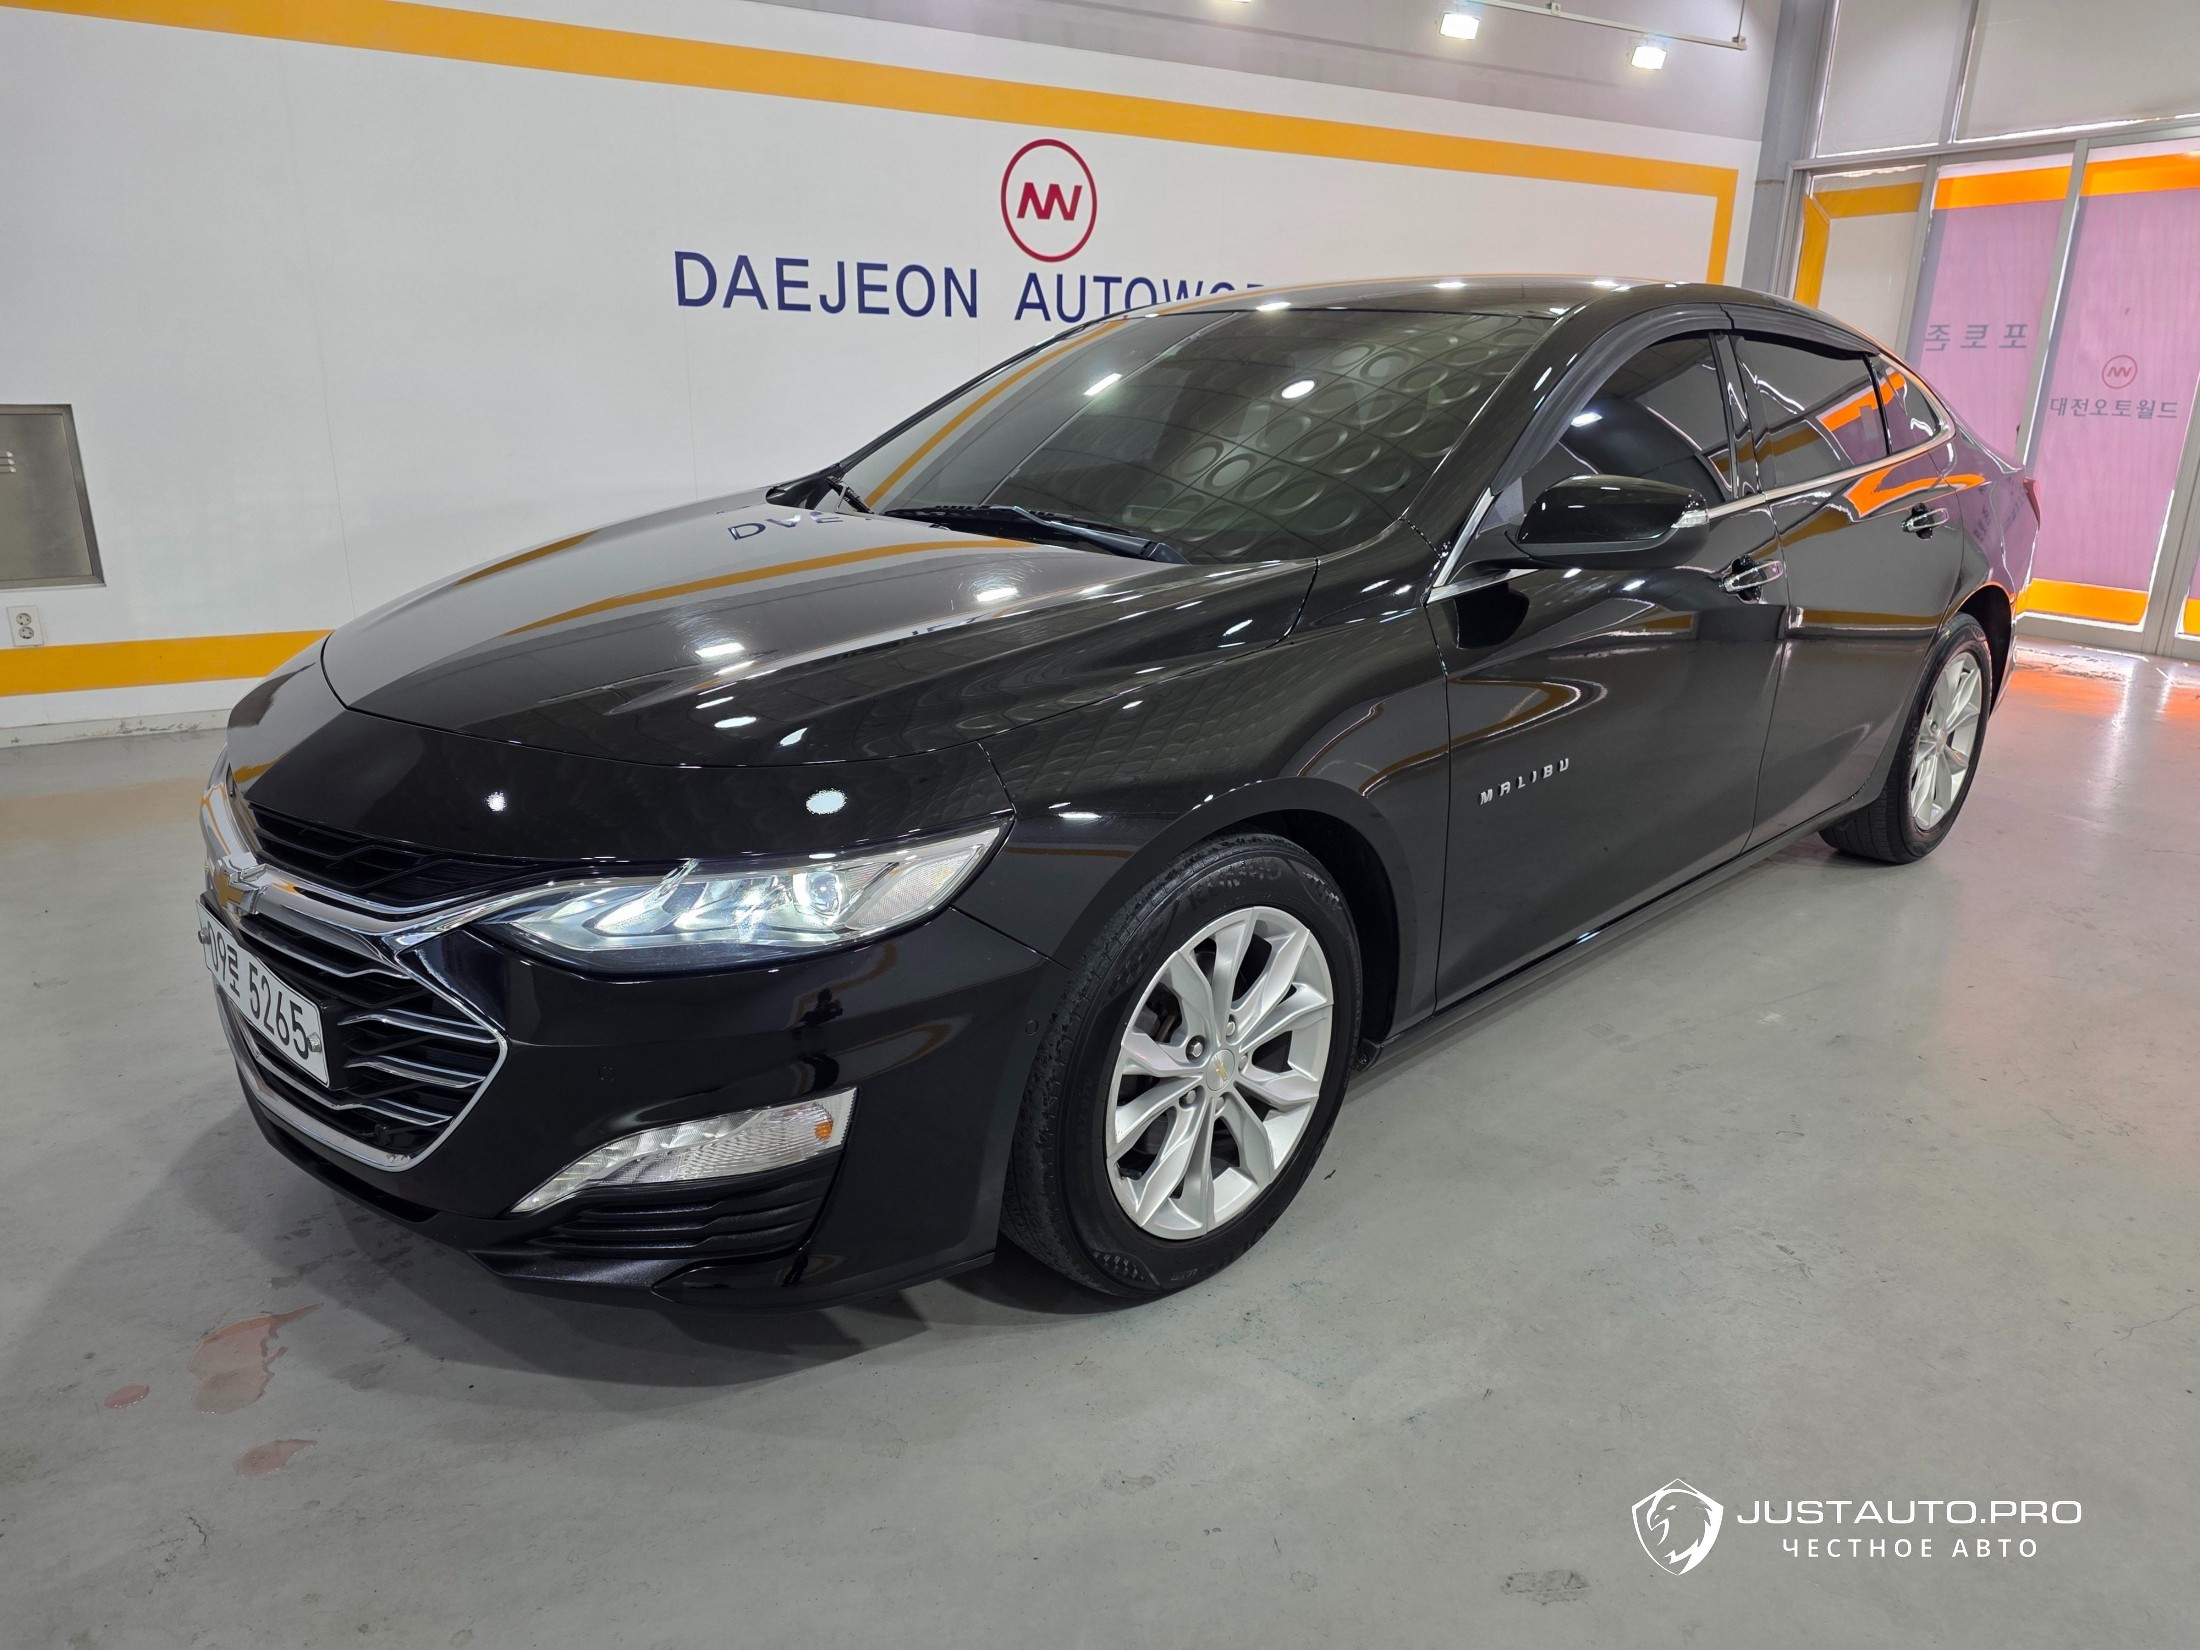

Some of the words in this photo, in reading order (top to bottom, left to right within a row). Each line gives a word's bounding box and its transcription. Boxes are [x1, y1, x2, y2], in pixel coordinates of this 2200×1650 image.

[674, 251, 978, 319] DAEJEON
[1014, 273, 1265, 323] AUTOW
[2050, 397, 2179, 420] 대전오토월드
[1479, 758, 1569, 805] MALIBU
[206, 920, 241, 998] 09로
[249, 961, 309, 1060] 5265
